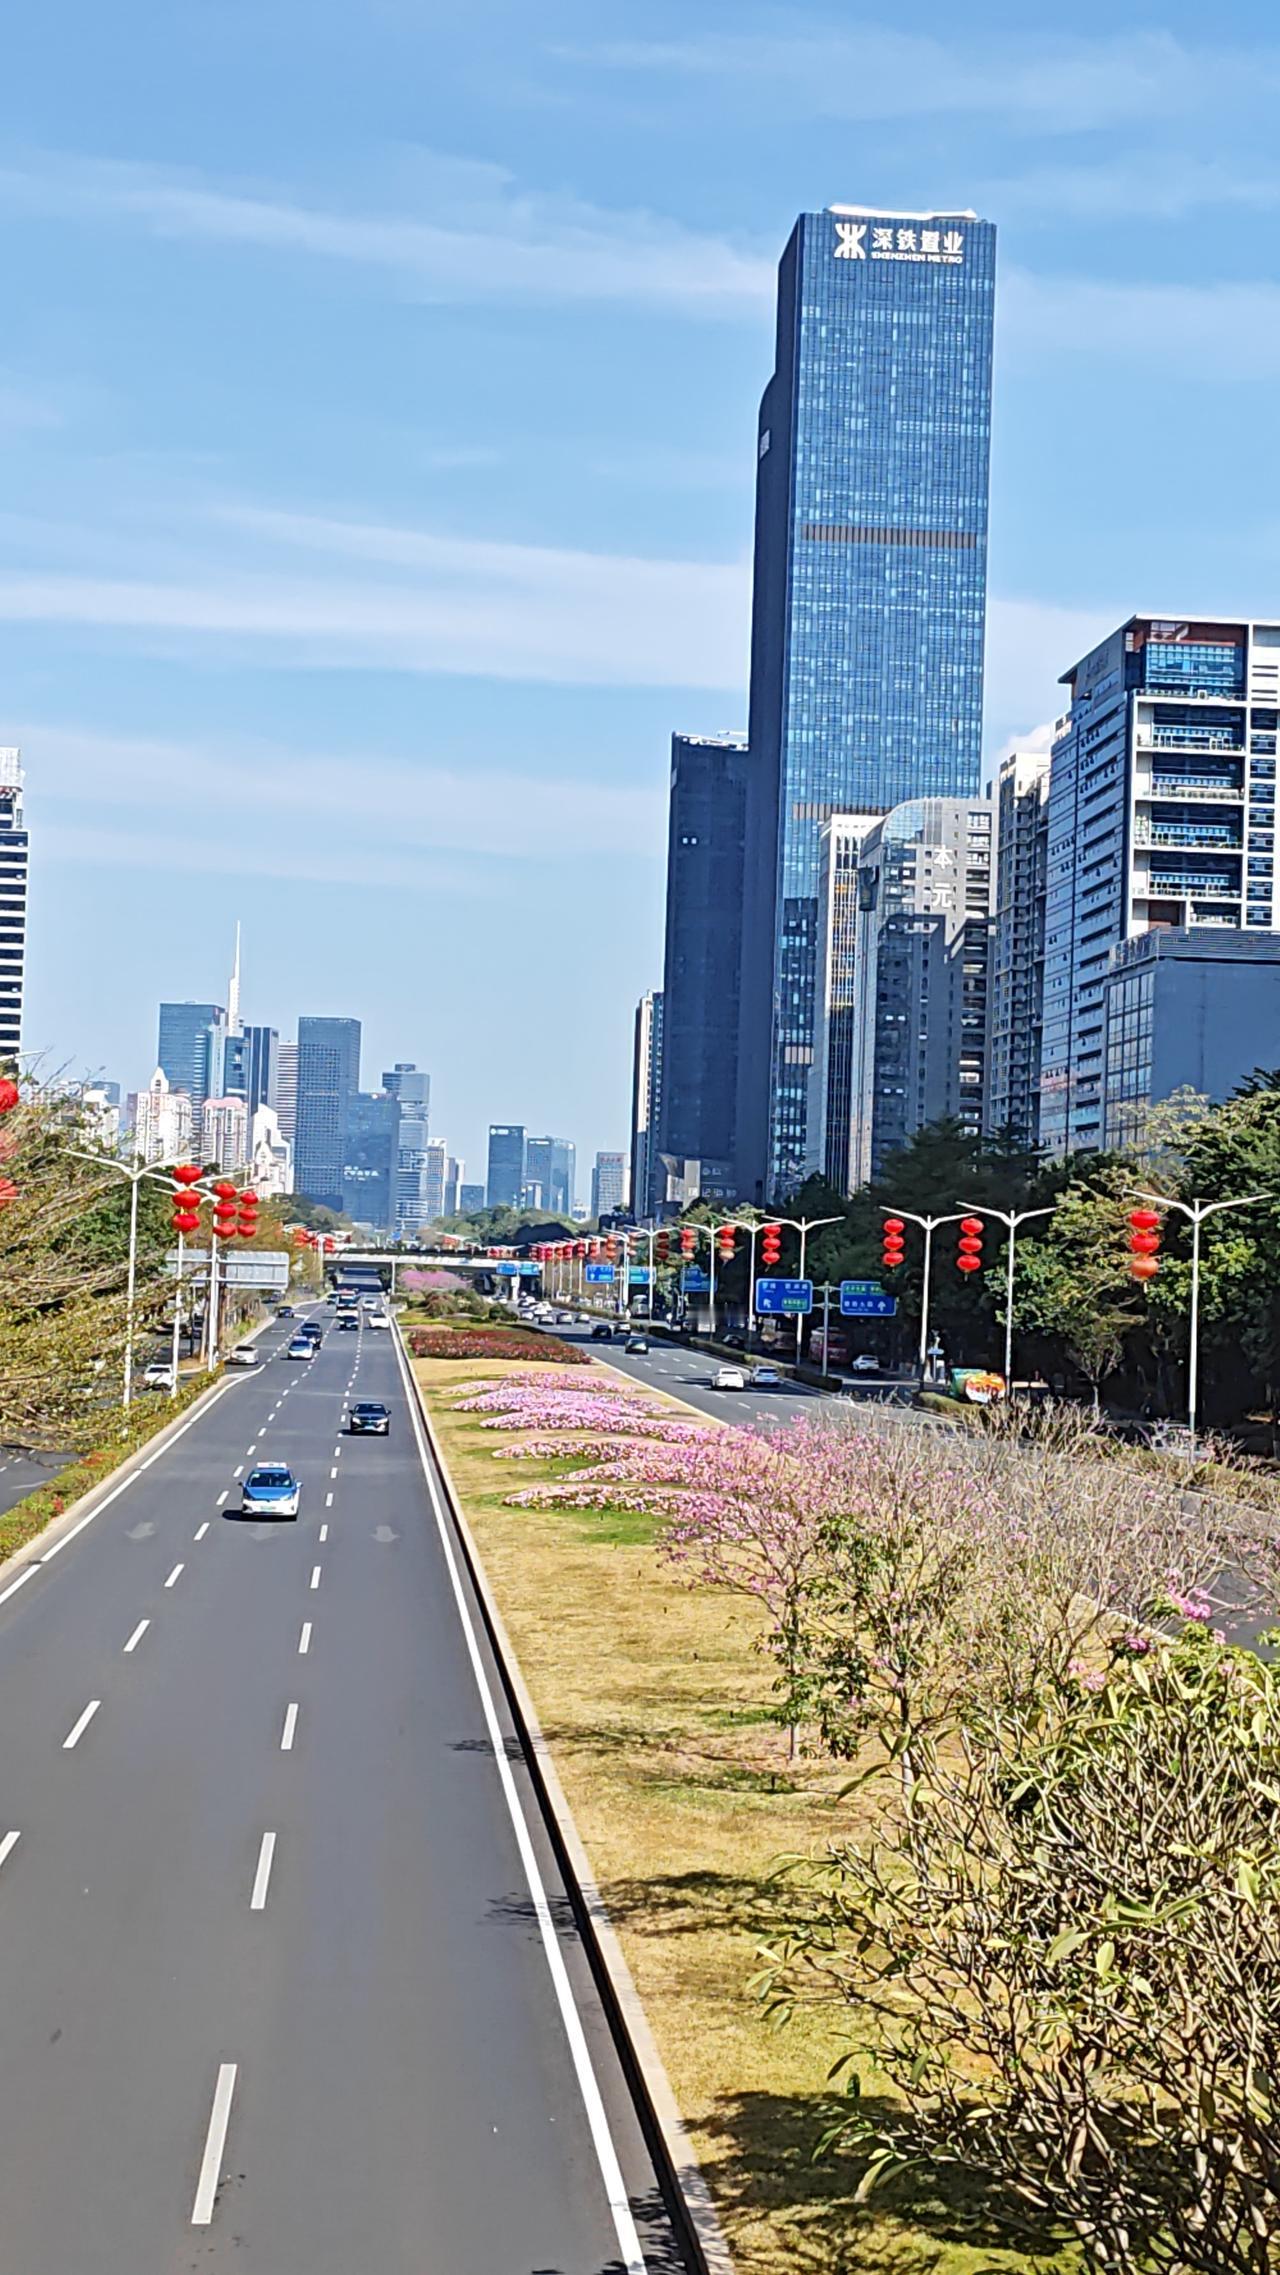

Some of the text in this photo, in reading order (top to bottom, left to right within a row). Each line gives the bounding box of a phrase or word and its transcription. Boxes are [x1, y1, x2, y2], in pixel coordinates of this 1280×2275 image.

[871, 227, 964, 254] 深铁置业
[932, 844, 953, 908] 本元
